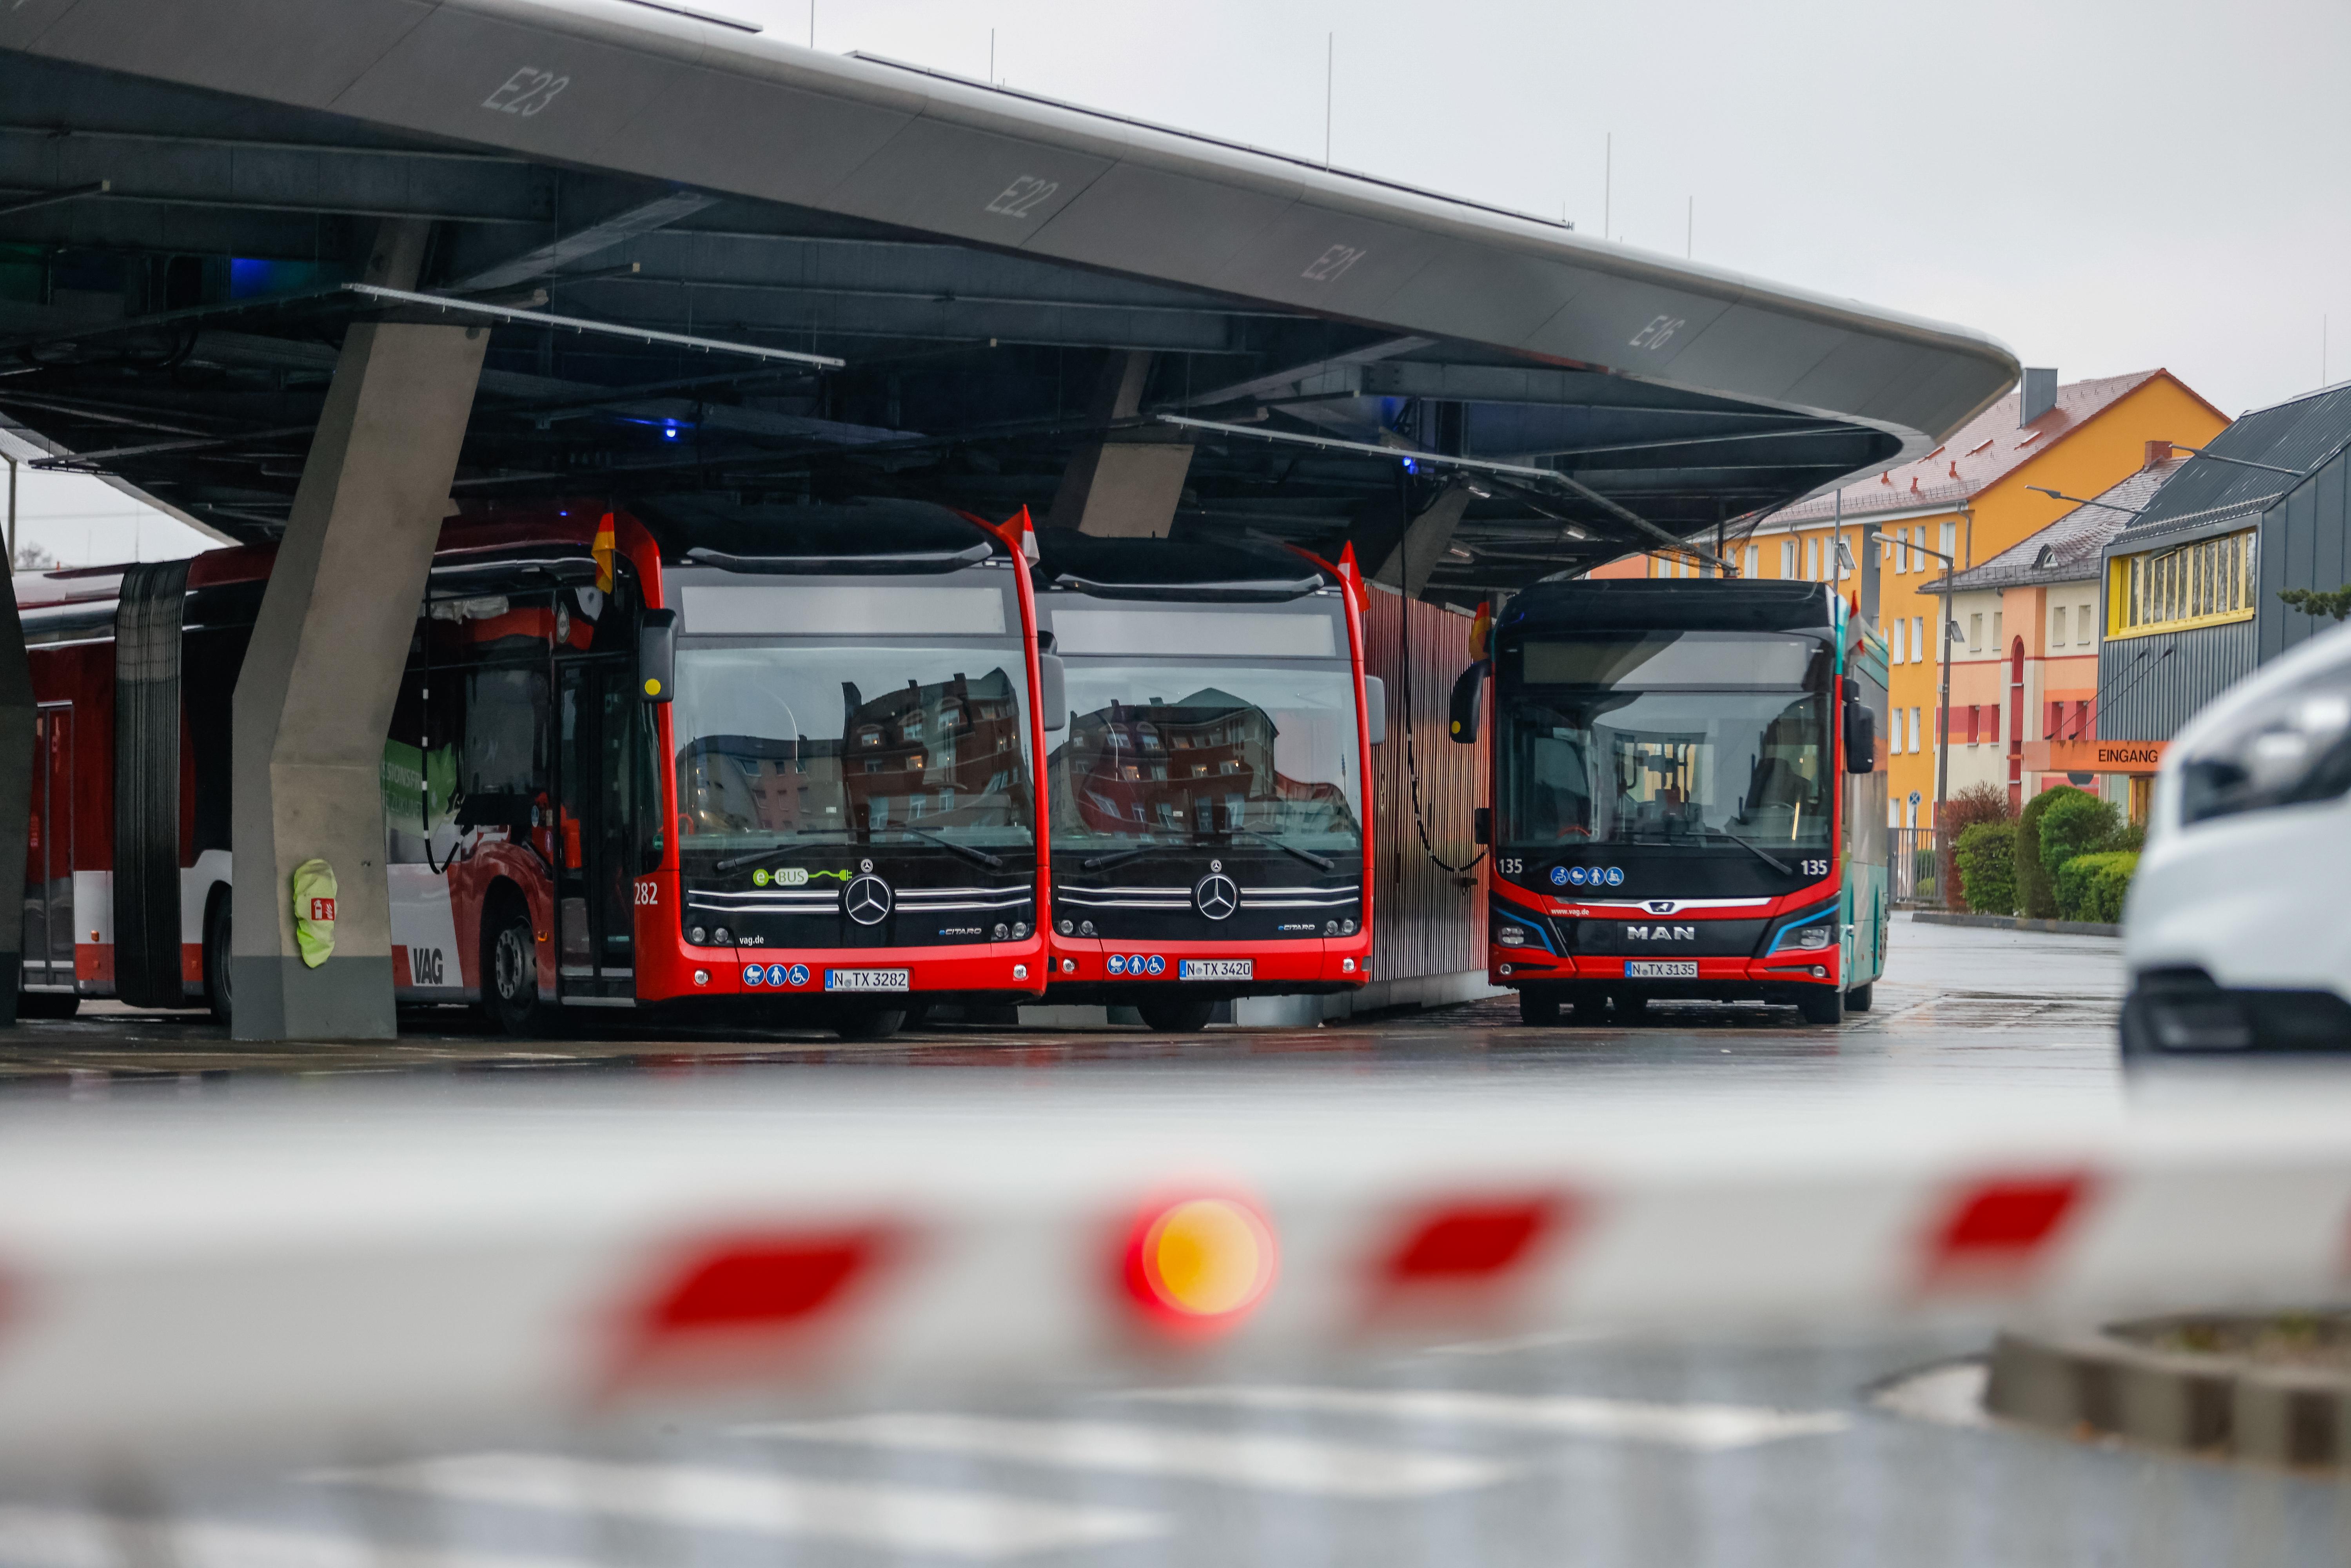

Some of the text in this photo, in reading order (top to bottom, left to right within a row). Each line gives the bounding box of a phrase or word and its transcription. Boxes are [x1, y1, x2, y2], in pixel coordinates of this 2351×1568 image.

[481, 67, 569, 116] E23
[986, 175, 1058, 218] E22
[1302, 244, 1366, 282] E21
[1630, 315, 1685, 349] E16
[2099, 749, 2158, 762] EINGANG
[1500, 858, 1522, 874] 135
[1801, 860, 1827, 875] 135
[757, 871, 804, 883] e BUS
[635, 882, 658, 905] 282
[1551, 908, 1590, 916] www.vag.de
[1627, 926, 1694, 940] MAN
[739, 935, 764, 946] vag.de
[414, 948, 443, 984] VAG
[1187, 963, 1195, 975] N
[1203, 963, 1218, 975] TX
[1221, 963, 1250, 975] 3420
[1633, 964, 1640, 975] N
[1648, 964, 1663, 975] TX
[1666, 964, 1695, 975] 3135
[835, 973, 843, 986] N
[853, 973, 869, 986] TX
[873, 973, 906, 986] 3282
